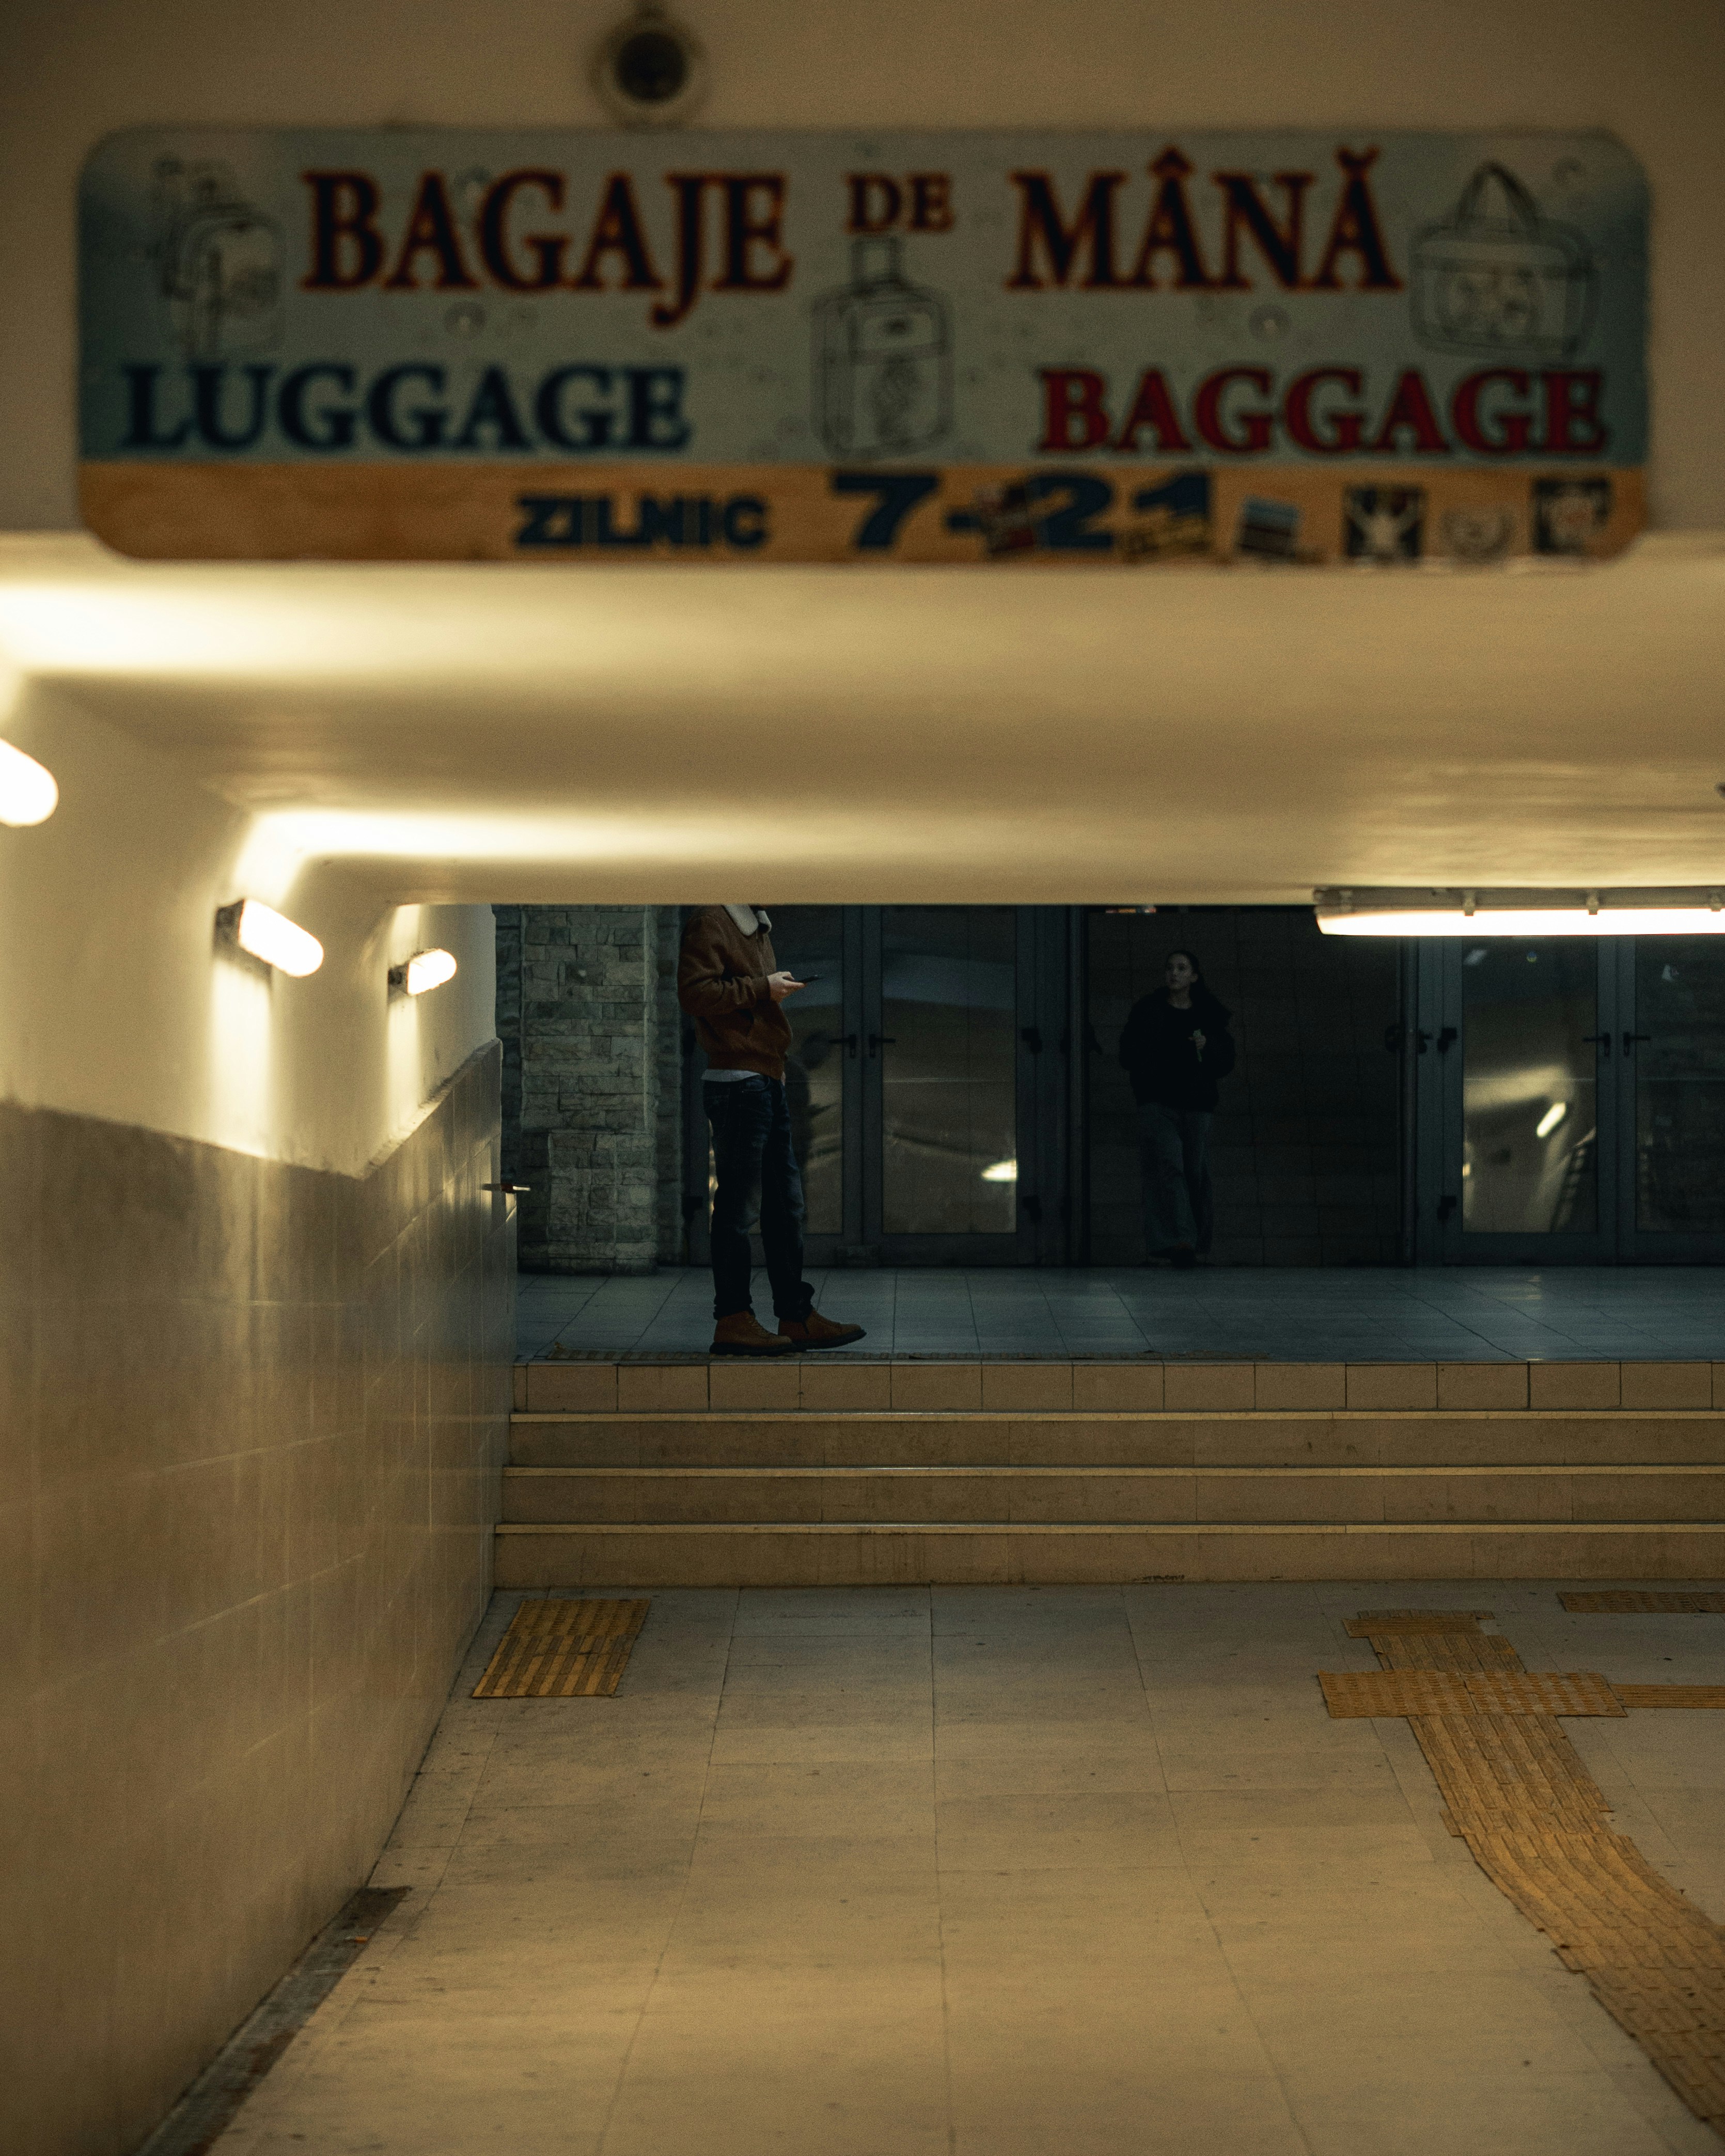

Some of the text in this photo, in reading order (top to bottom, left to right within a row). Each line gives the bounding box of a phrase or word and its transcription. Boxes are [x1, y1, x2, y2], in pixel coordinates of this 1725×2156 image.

[301, 147, 1404, 327] BAGAJE DE MÂNĂ
[121, 361, 691, 453] LUGGAGE
[1038, 366, 1608, 454] BAGGAGE
[515, 492, 768, 548] ZILNIC
